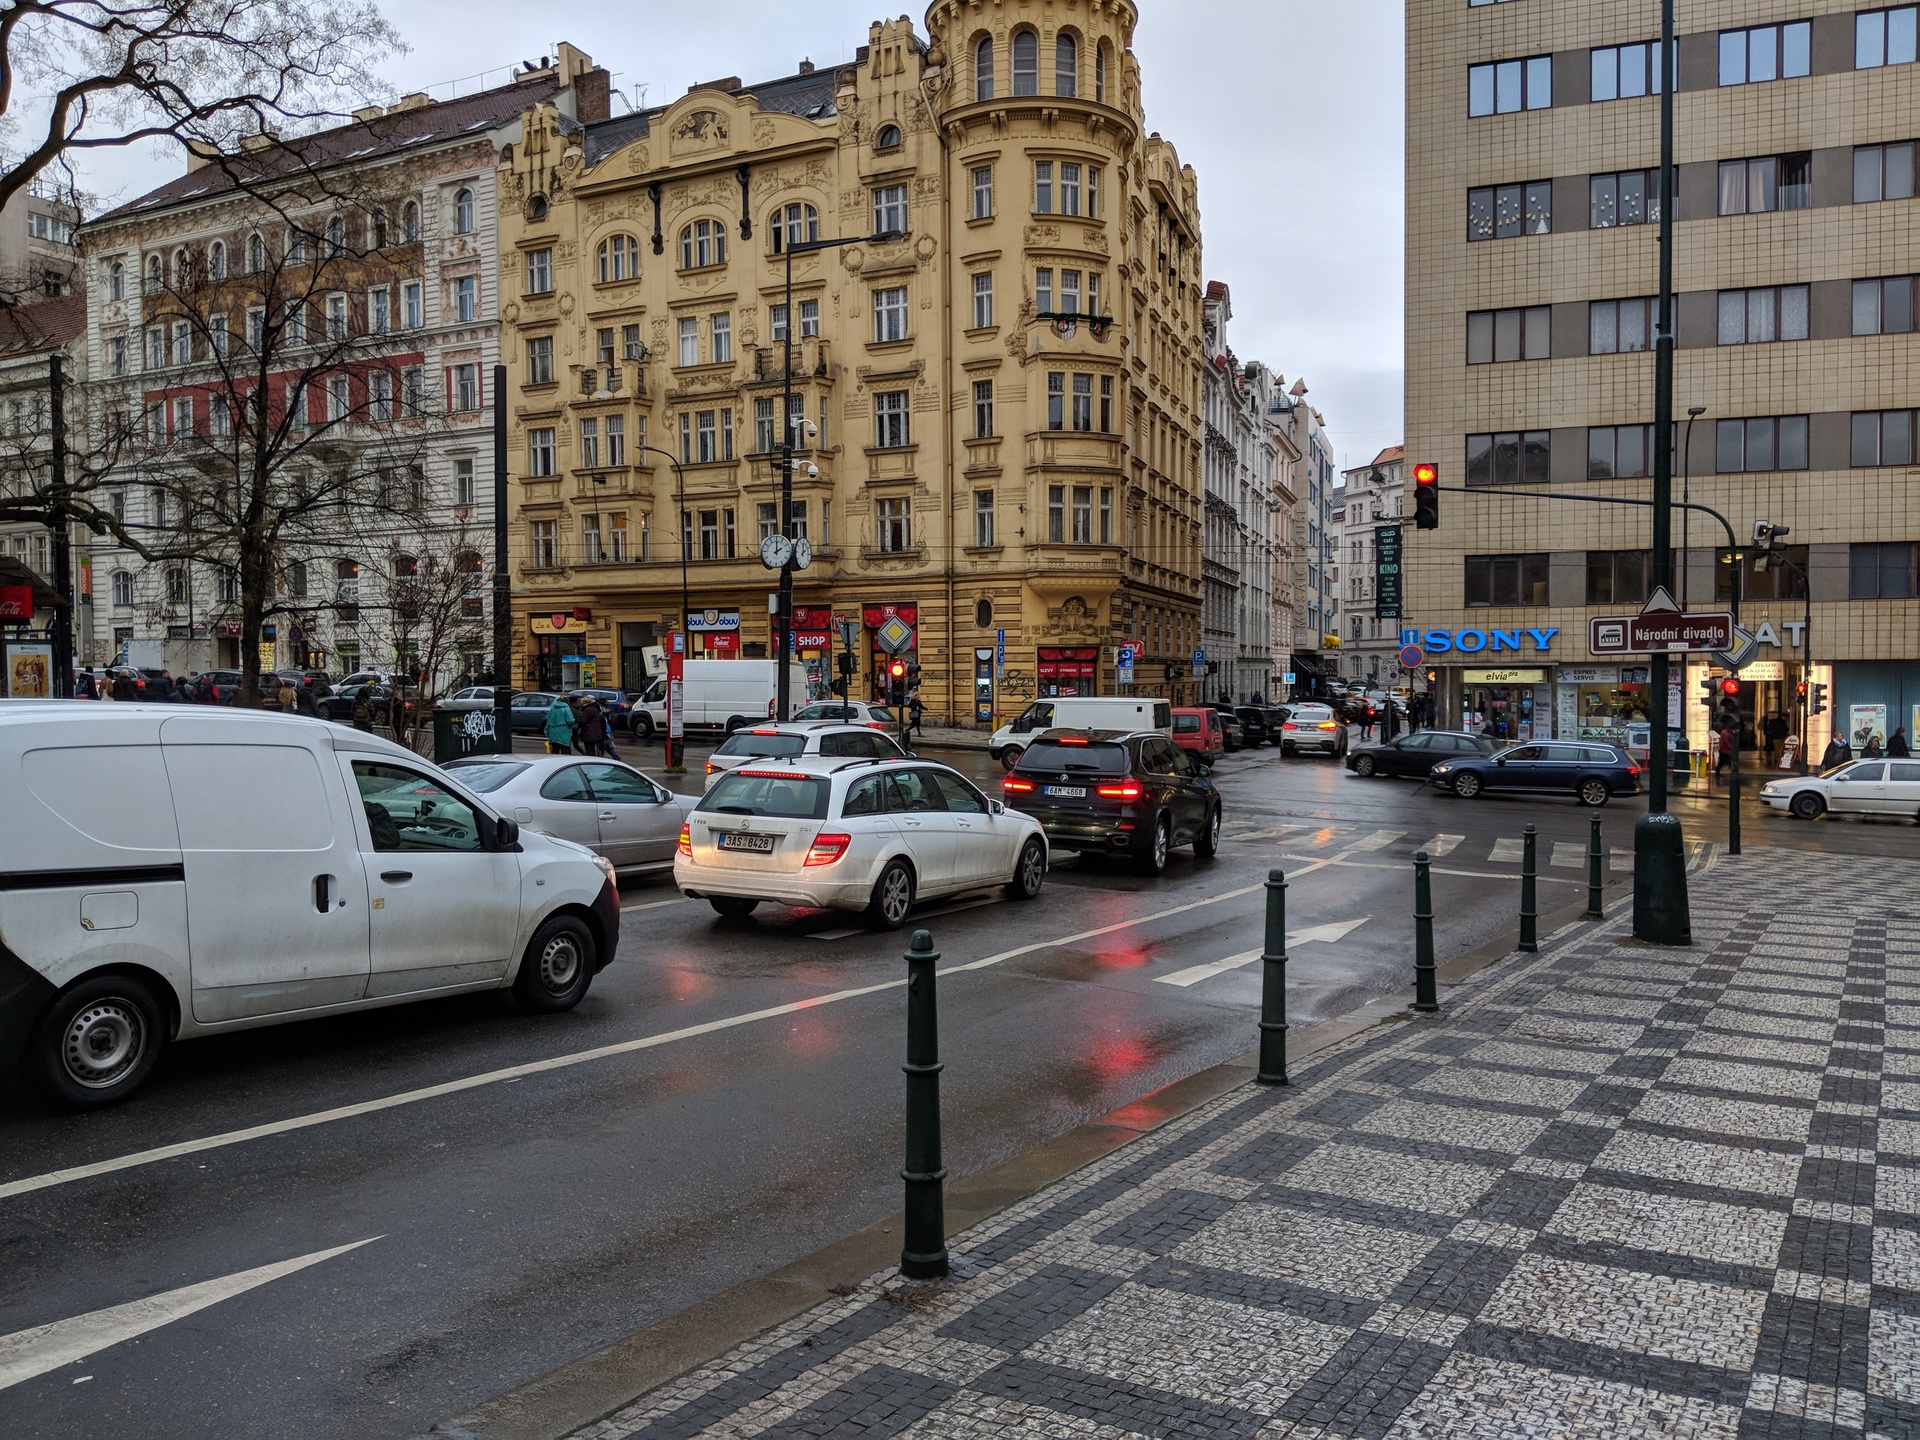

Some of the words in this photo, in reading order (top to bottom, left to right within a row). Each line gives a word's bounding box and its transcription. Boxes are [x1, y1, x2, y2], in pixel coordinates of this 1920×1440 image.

[1295, 506, 1307, 557] HOUSE
[1379, 563, 1398, 574] KINO
[1295, 565, 1307, 629] MOSAIC
[719, 617, 738, 625] obuv
[1635, 627, 1680, 641] Národní
[1683, 626, 1724, 639] divadlo
[1739, 621, 1806, 647] AT
[798, 636, 826, 646] SHOP
[1424, 628, 1559, 653] SONY
[22, 674, 39, 685] 30
[1485, 672, 1508, 681] elvia
[1049, 786, 1062, 795] 6AM
[1066, 787, 1083, 796] 4668
[726, 836, 742, 847] 3AS
[747, 837, 769, 849] 8428
